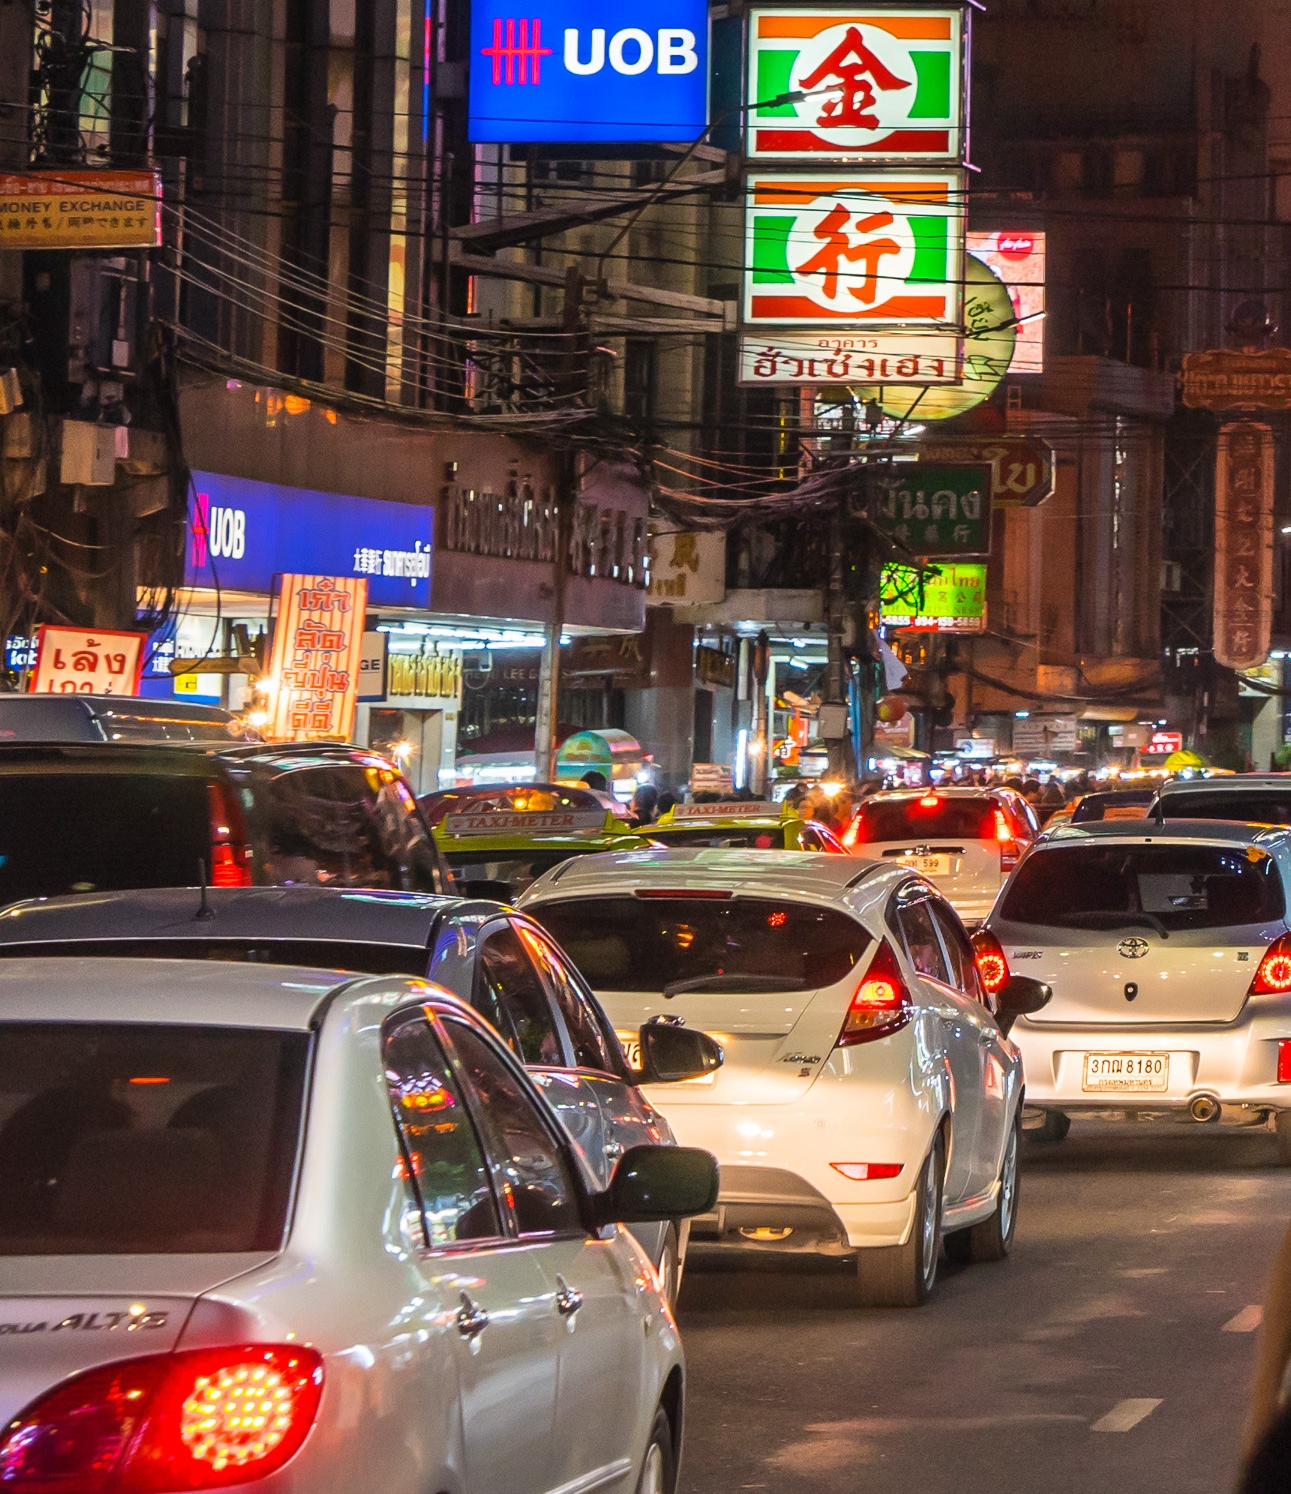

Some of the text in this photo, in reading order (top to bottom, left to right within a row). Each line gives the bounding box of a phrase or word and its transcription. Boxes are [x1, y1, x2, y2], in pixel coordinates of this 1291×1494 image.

[563, 27, 698, 76] UOB
[59, 200, 145, 212] EXCHANGE
[818, 338, 878, 349] อาคาร
[209, 506, 246, 560] UOB
[52, 638, 127, 675] เล้ง
[686, 804, 761, 815] TAXI-METER
[466, 814, 575, 829] TAXI-METER
[1127, 1058, 1163, 1074] 8180
